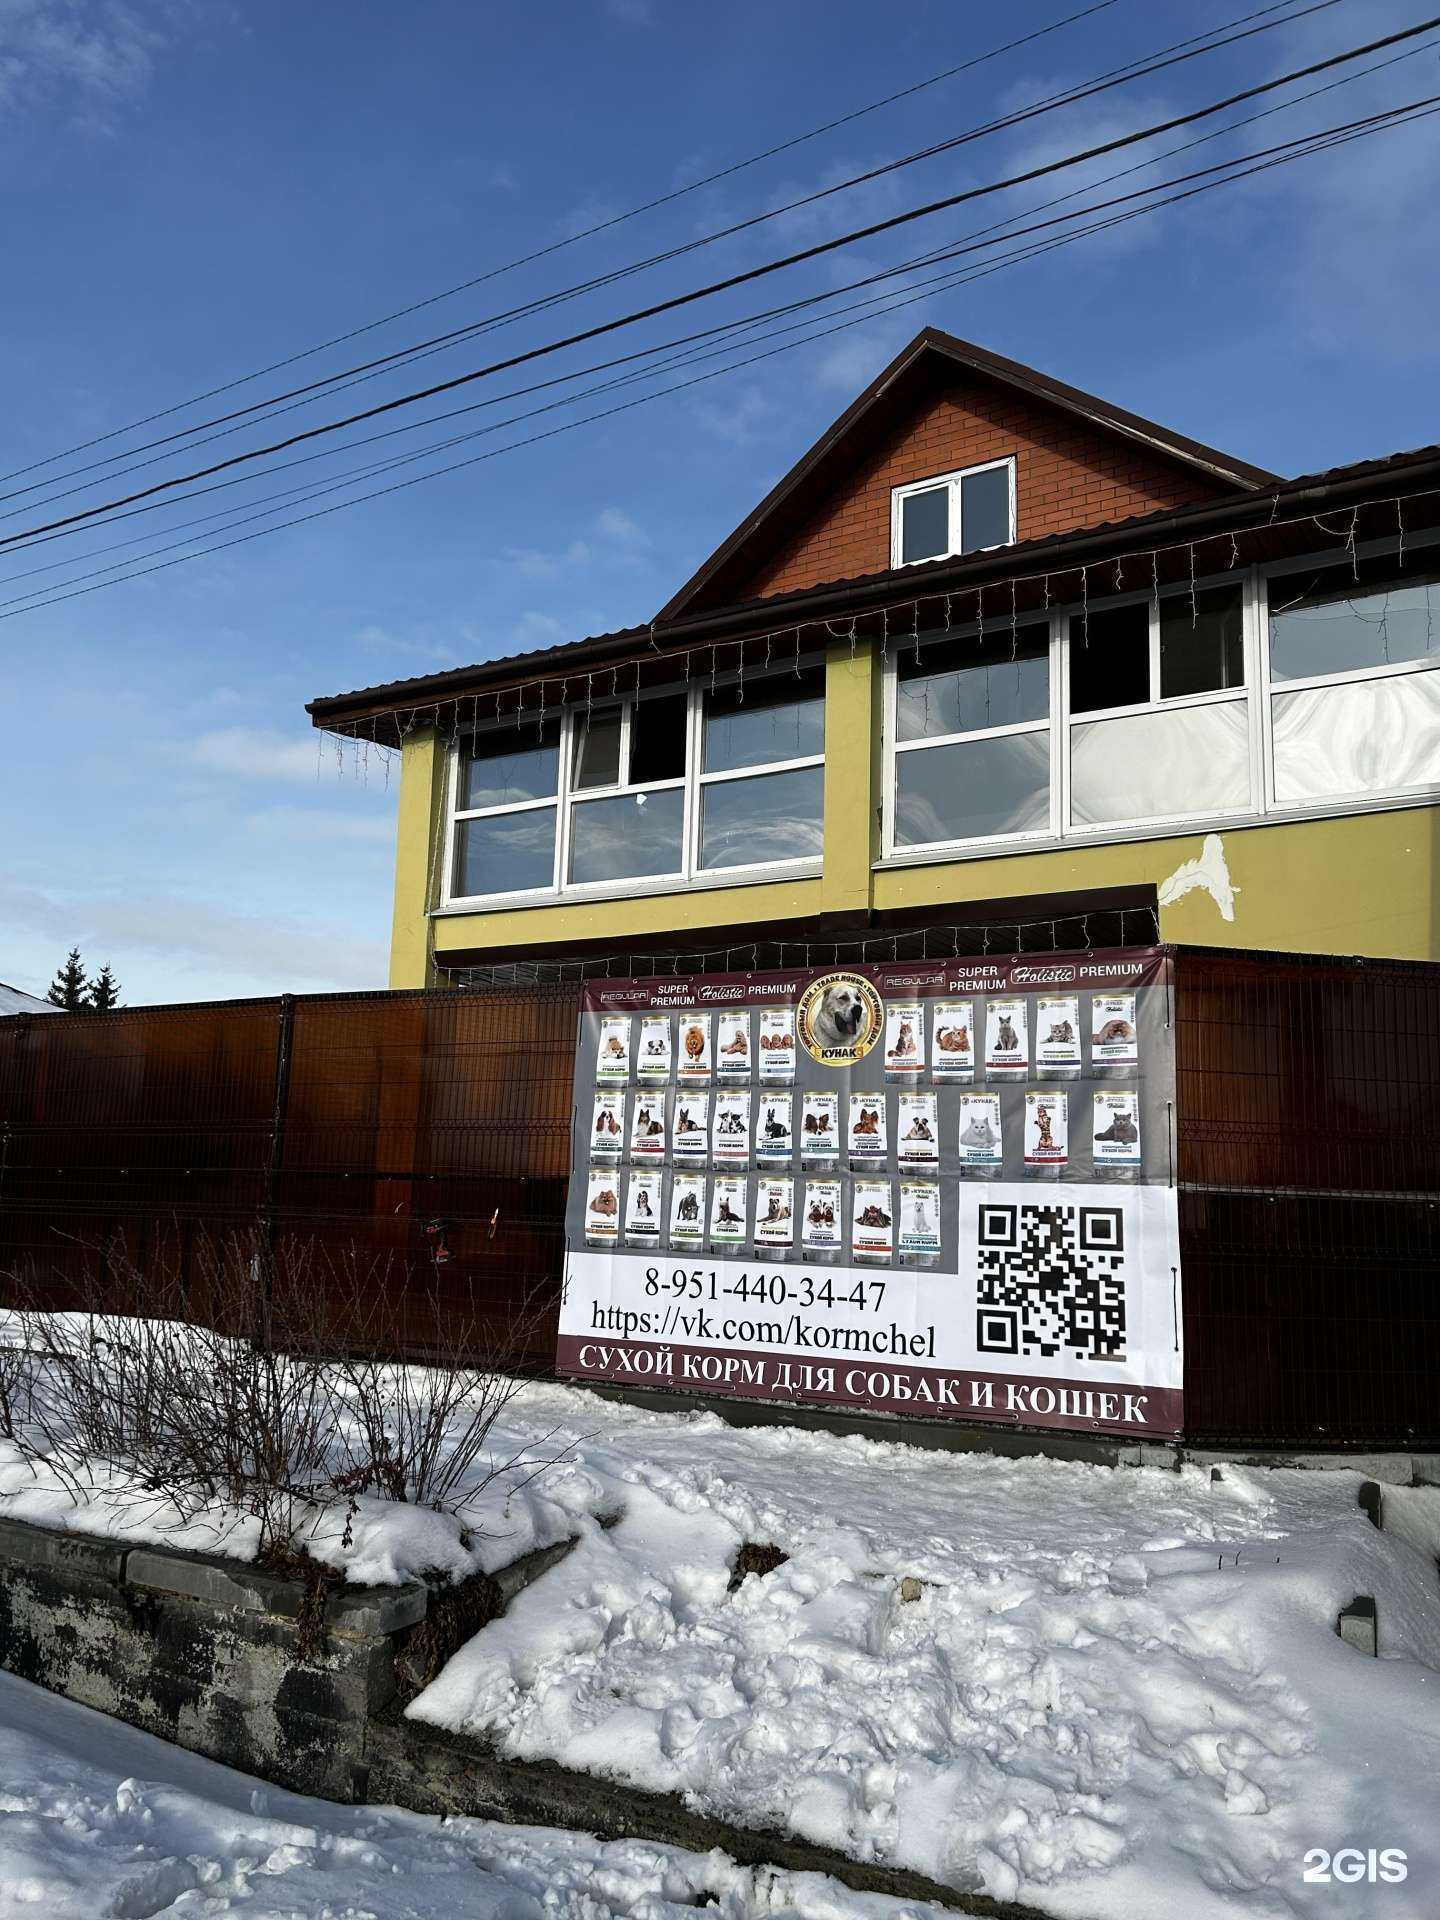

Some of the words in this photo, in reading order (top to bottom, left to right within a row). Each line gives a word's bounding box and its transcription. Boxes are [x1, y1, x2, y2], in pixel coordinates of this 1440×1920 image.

[816, 975, 840, 988] TRADE
[840, 975, 863, 987] HOUSE
[886, 975, 944, 986] REGULAR
[949, 980, 1006, 992] PREMIUM
[1013, 967, 1073, 983] Holistic
[1079, 963, 1143, 977] PREMIUM
[958, 966, 998, 978] SUPER
[650, 996, 695, 1006] PREMIUM
[701, 985, 743, 999] Holistic
[748, 984, 796, 995] PREMIUM
[657, 984, 689, 995] SUPER
[821, 1048, 857, 1058] КУНАК
[645, 1267, 886, 1313] 8-951-440-34-47
[590, 1300, 937, 1358] https://vk.com/kormchel
[578, 1343, 674, 1376] СУХОЙ
[683, 1354, 767, 1385] КОРМ
[771, 1362, 836, 1397] ДЛЯ
[845, 1370, 961, 1405] СОБАК
[967, 1380, 997, 1409] И
[1004, 1383, 1149, 1424] КОШЕК
